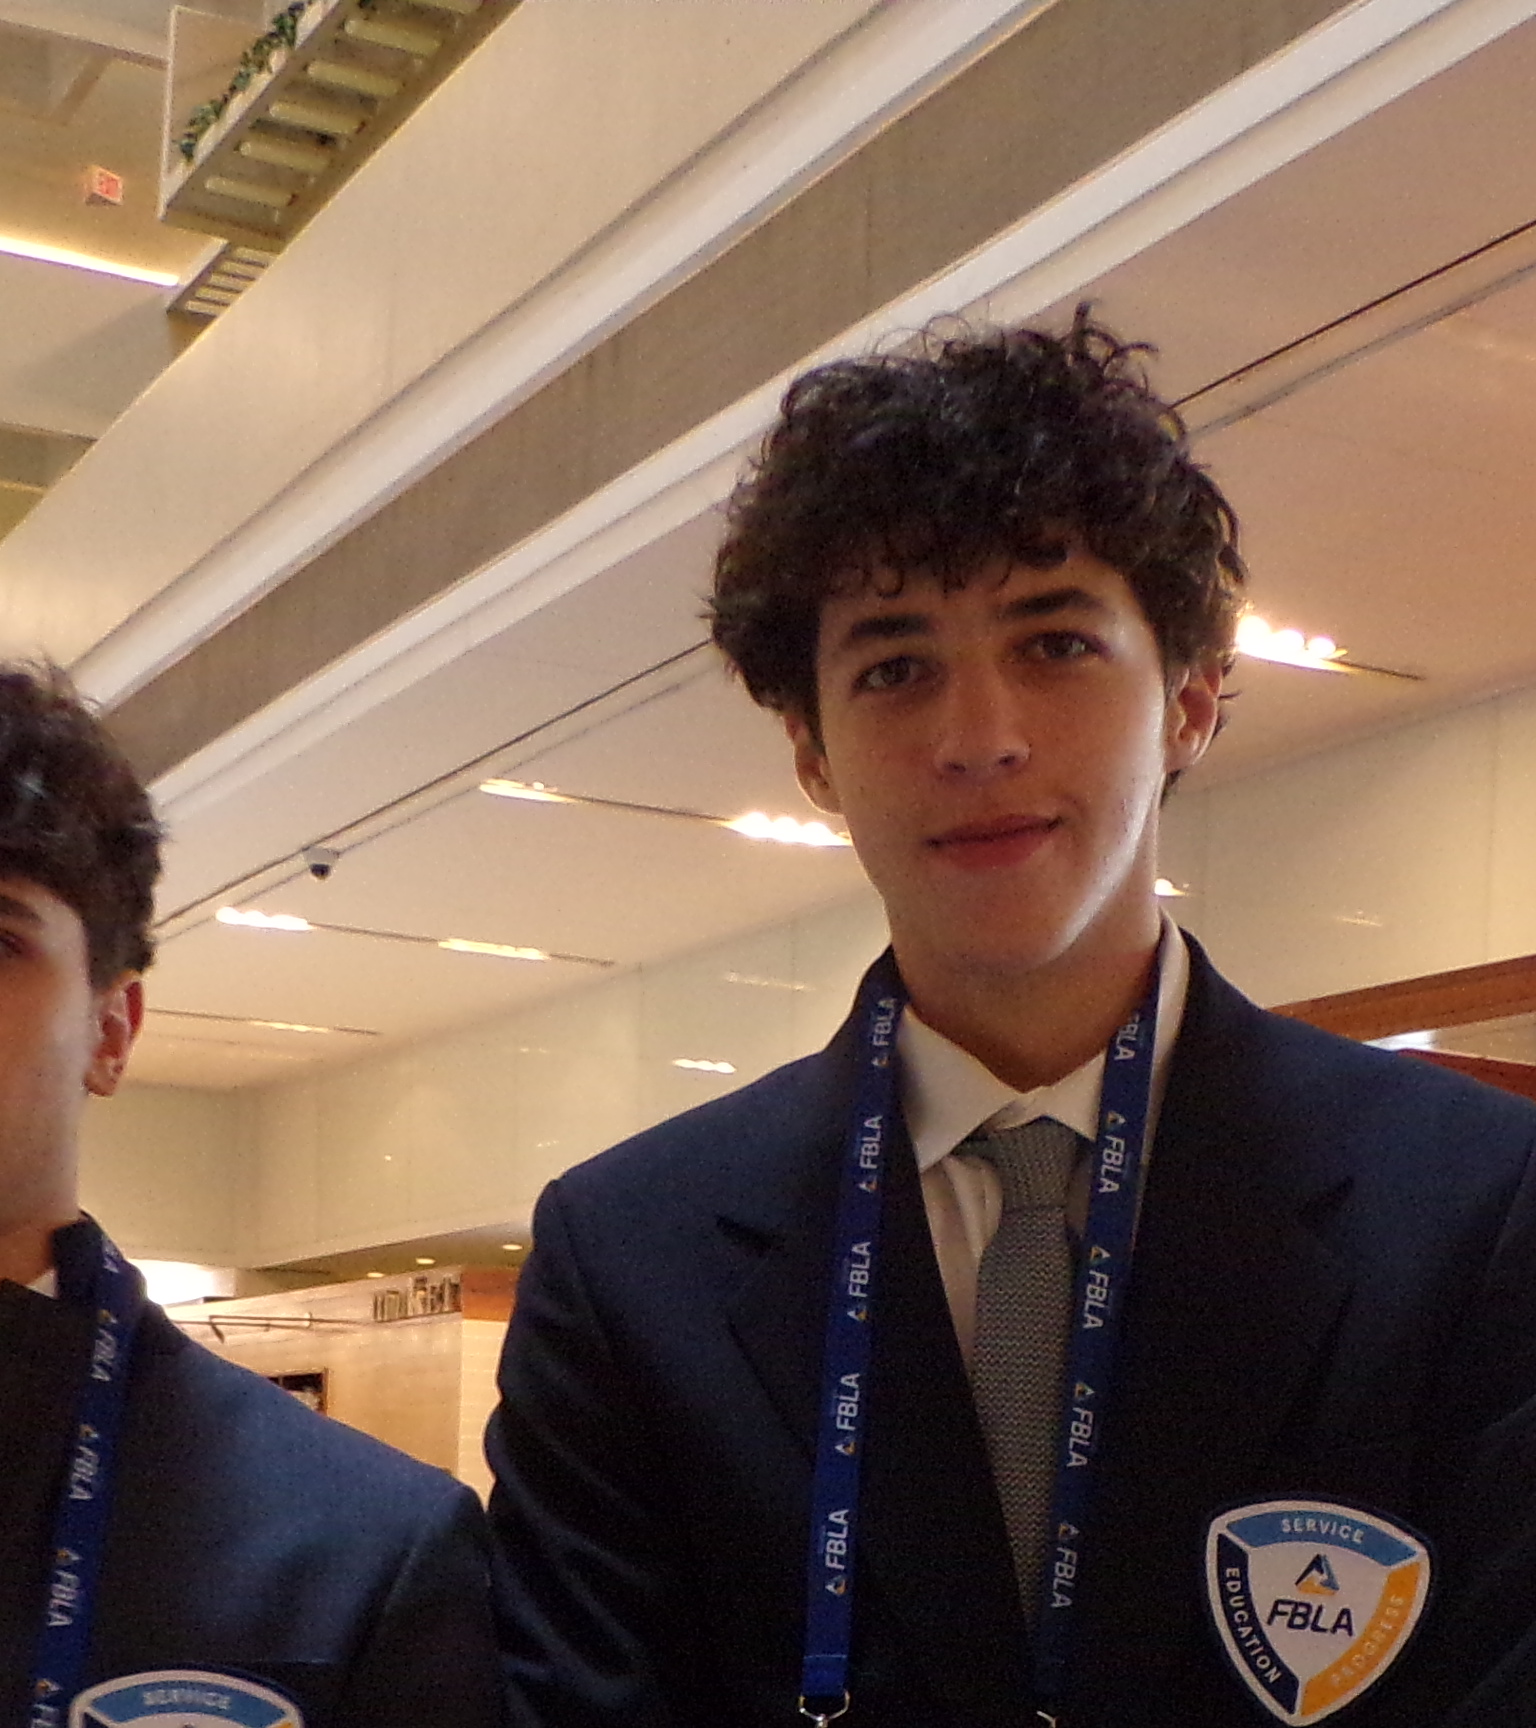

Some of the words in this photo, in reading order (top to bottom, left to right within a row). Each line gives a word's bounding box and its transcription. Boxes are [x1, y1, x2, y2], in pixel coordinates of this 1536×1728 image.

[871, 996, 898, 1046] FBLA
[859, 1114, 884, 1170] FBLA
[1097, 1135, 1126, 1194] FBLA
[848, 1240, 872, 1298] FBLA
[1082, 1269, 1111, 1330] FBLA
[836, 1372, 861, 1431] FBLA
[1066, 1405, 1095, 1468] FBLA
[825, 1508, 850, 1571] FBLA
[1281, 1516, 1365, 1545] SERVICE
[1050, 1545, 1079, 1610] FBLA
[1224, 1567, 1283, 1685] EDUCATION
[1267, 1598, 1356, 1637] FBLA
